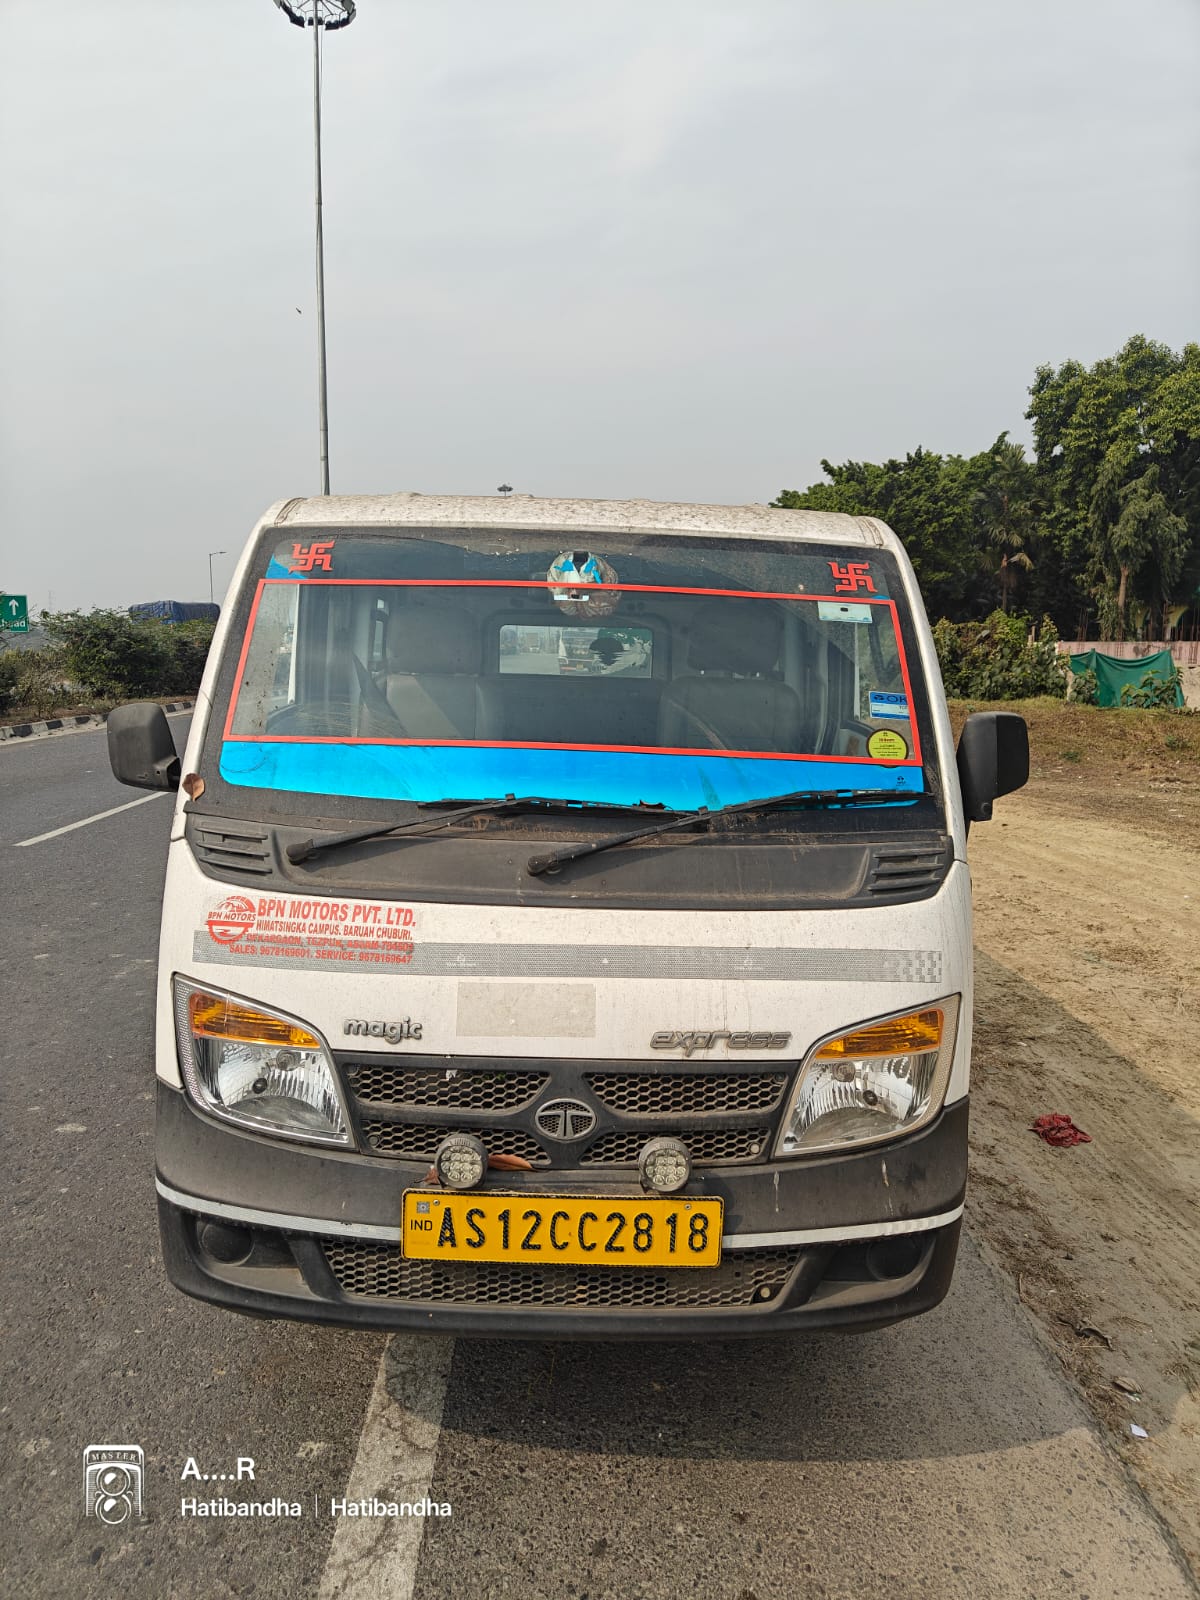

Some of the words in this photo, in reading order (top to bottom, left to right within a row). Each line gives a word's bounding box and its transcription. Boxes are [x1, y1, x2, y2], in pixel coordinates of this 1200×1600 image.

[207, 911, 223, 919] BPN
[224, 912, 256, 921] MOTORS
[257, 898, 287, 917] BPN
[289, 901, 349, 921] MOTORS
[352, 905, 382, 924] PVT.
[386, 907, 416, 926] LTD.
[256, 920, 307, 933] HIMATSINGKA
[343, 925, 375, 938] BARUAH
[343, 1015, 423, 1045] magic
[650, 1030, 791, 1058] express
[410, 1219, 433, 1231] IND
[437, 1206, 709, 1253] AS12CC2818
